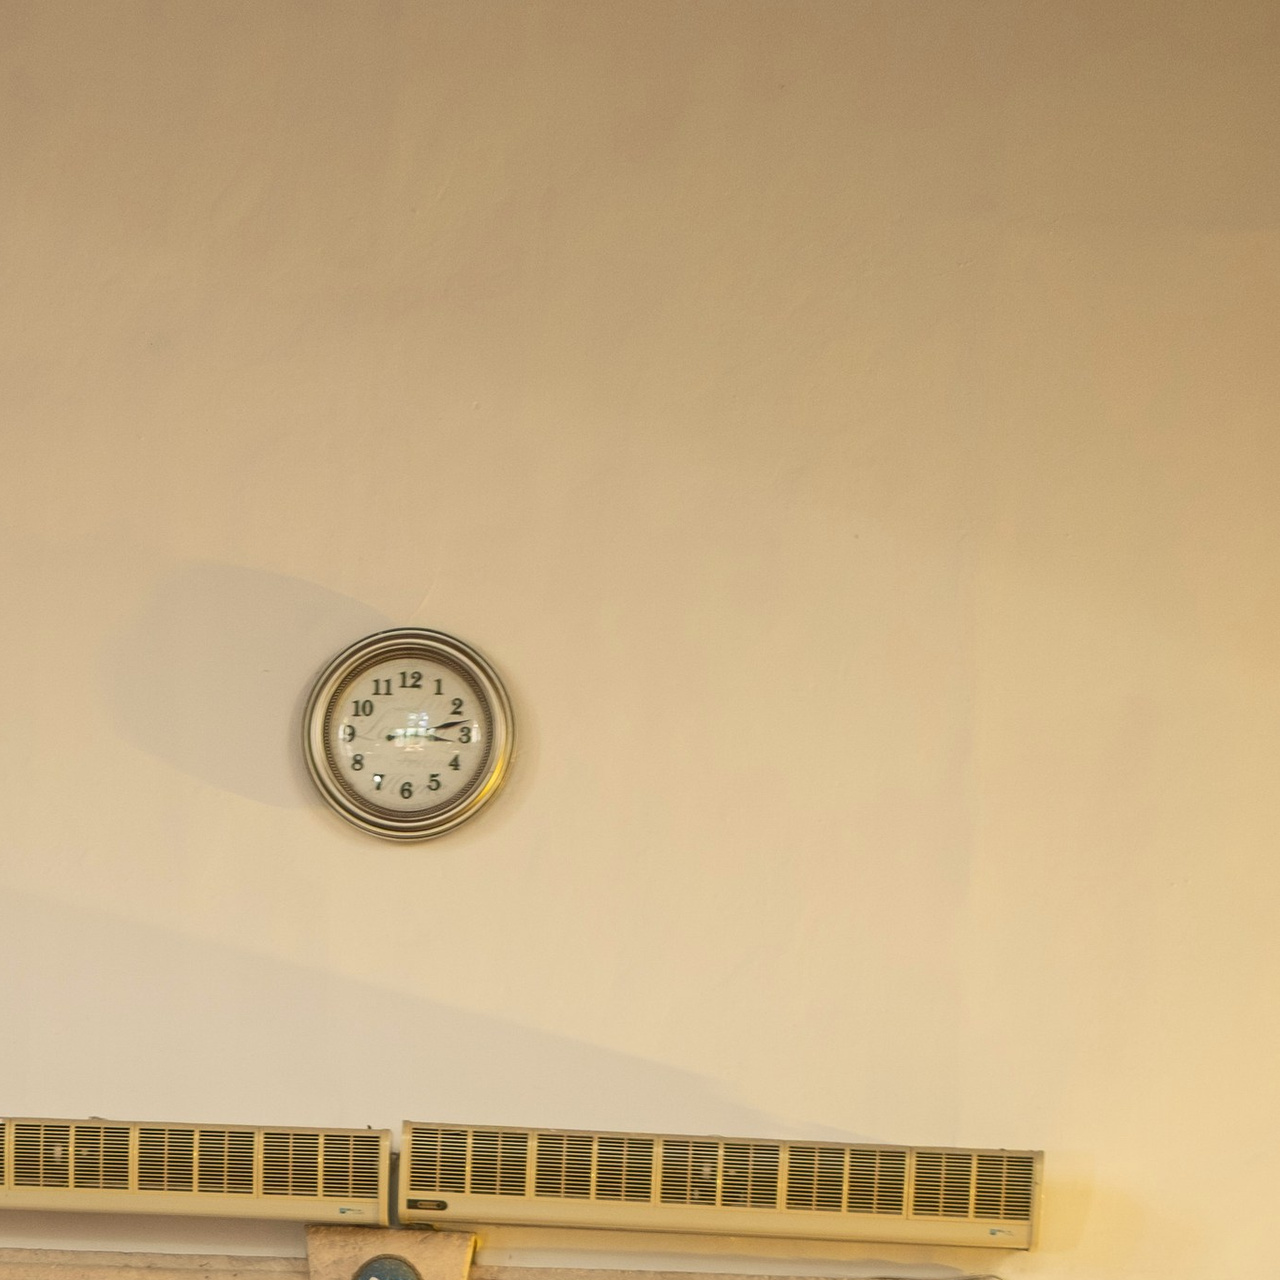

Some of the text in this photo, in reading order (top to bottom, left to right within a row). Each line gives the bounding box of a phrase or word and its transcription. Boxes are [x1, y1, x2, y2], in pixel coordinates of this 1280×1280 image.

[372, 678, 393, 695] 11
[398, 671, 422, 689] 12
[434, 678, 444, 695] 1
[352, 700, 374, 717] 10
[451, 698, 464, 715] 2
[342, 725, 356, 742] 9
[458, 726, 472, 744] 3
[351, 754, 364, 771] 8
[449, 754, 461, 771] 4
[373, 773, 385, 790] 7
[427, 773, 441, 790] 5
[400, 782, 412, 799] 6
